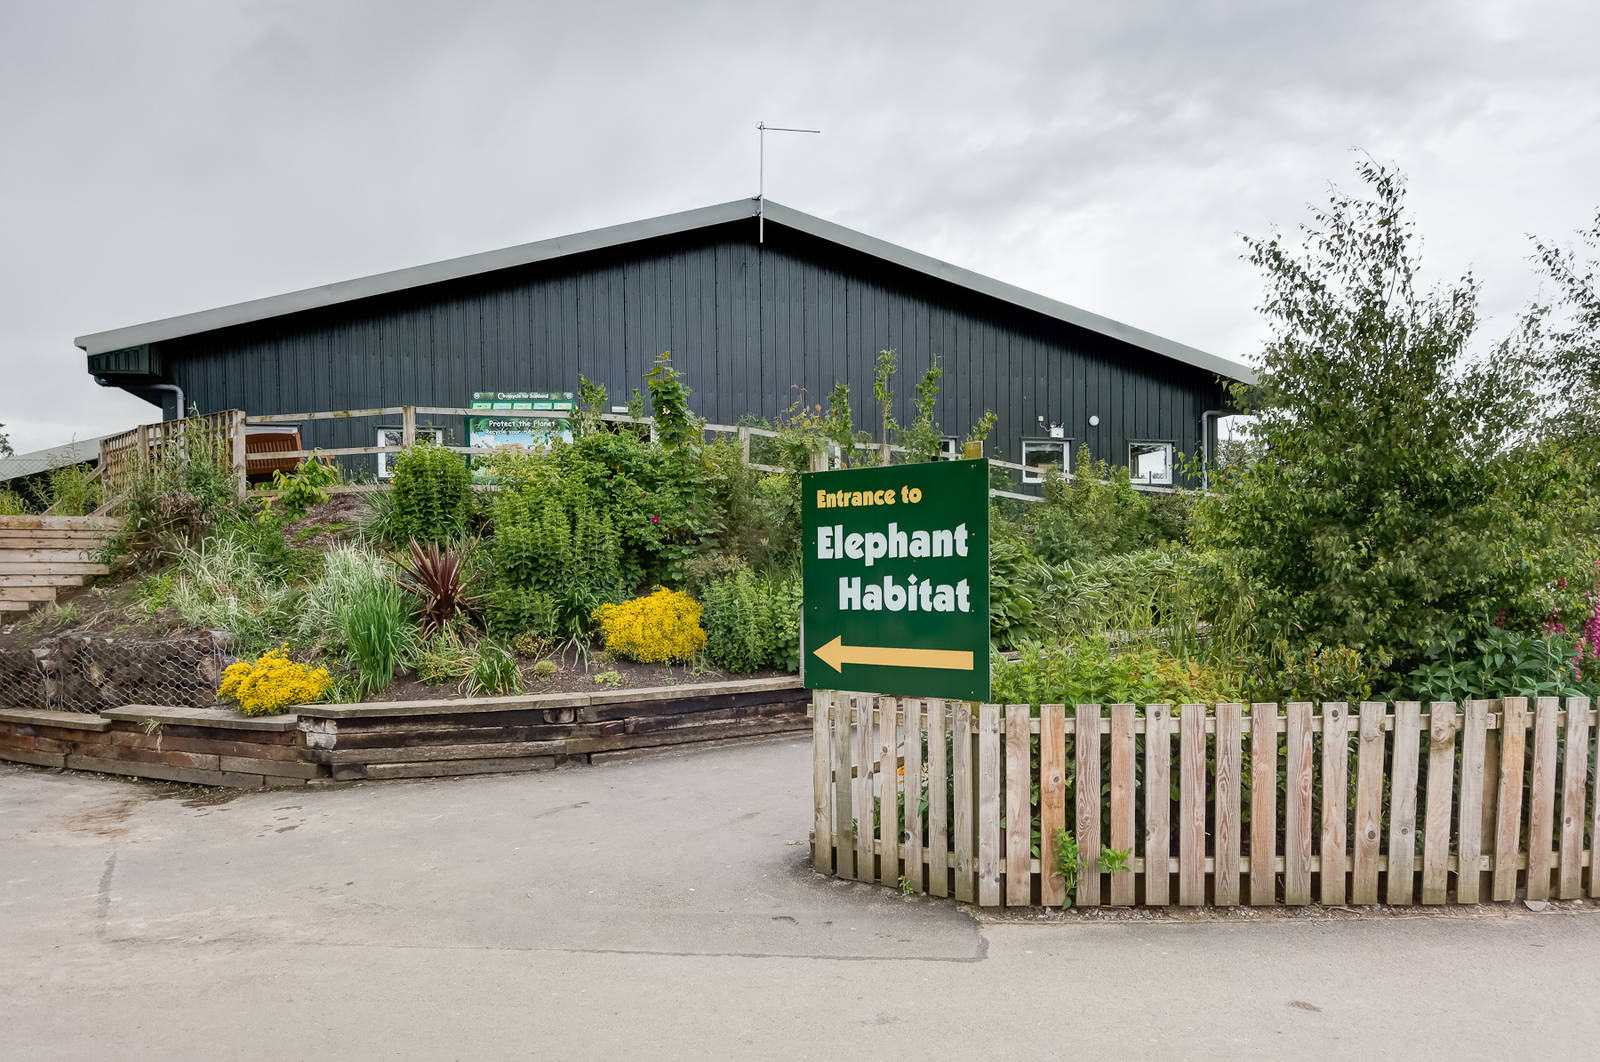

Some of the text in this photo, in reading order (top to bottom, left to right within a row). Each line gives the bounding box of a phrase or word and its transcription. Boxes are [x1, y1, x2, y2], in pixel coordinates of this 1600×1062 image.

[488, 419, 515, 427] Protect
[533, 419, 556, 427] Planet
[817, 485, 922, 508] Entrance to
[817, 522, 968, 566] Elephant
[839, 573, 970, 612] Habitat
